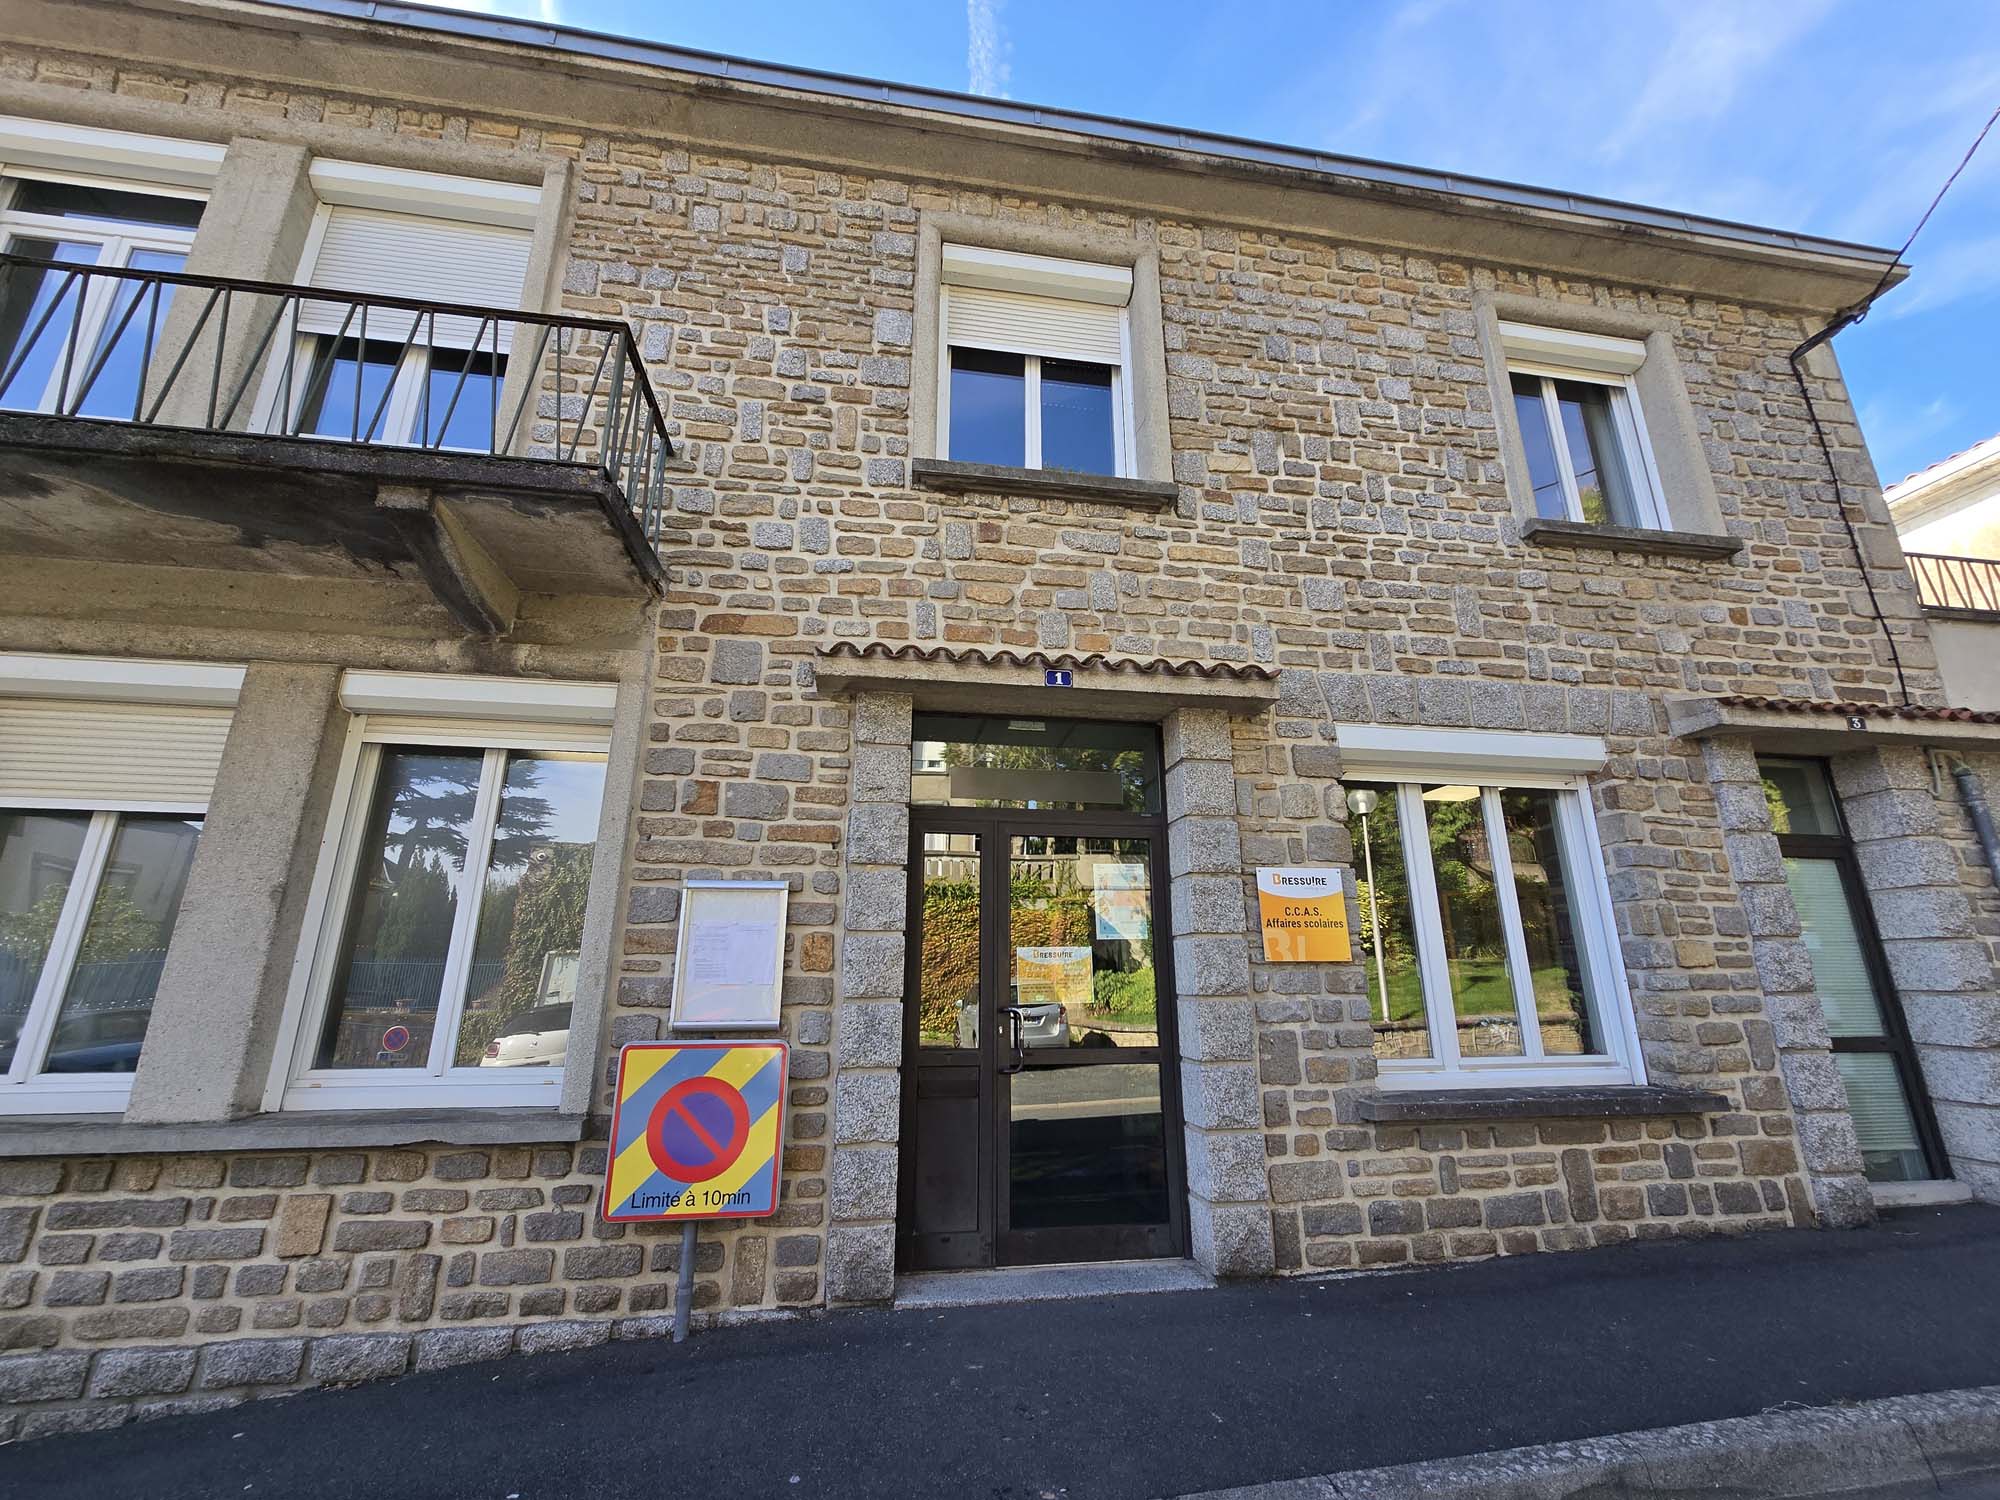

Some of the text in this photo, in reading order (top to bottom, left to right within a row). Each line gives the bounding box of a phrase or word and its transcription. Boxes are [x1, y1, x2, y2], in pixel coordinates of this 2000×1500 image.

[1055, 672, 1063, 684] 1
[1852, 718, 1861, 728] 3
[1272, 873, 1327, 886] BRESSUIRE
[1284, 906, 1322, 917] C.C.A.S.
[1266, 918, 1344, 929] Affaires scolaires
[631, 1189, 750, 1209] Limité à 10min
